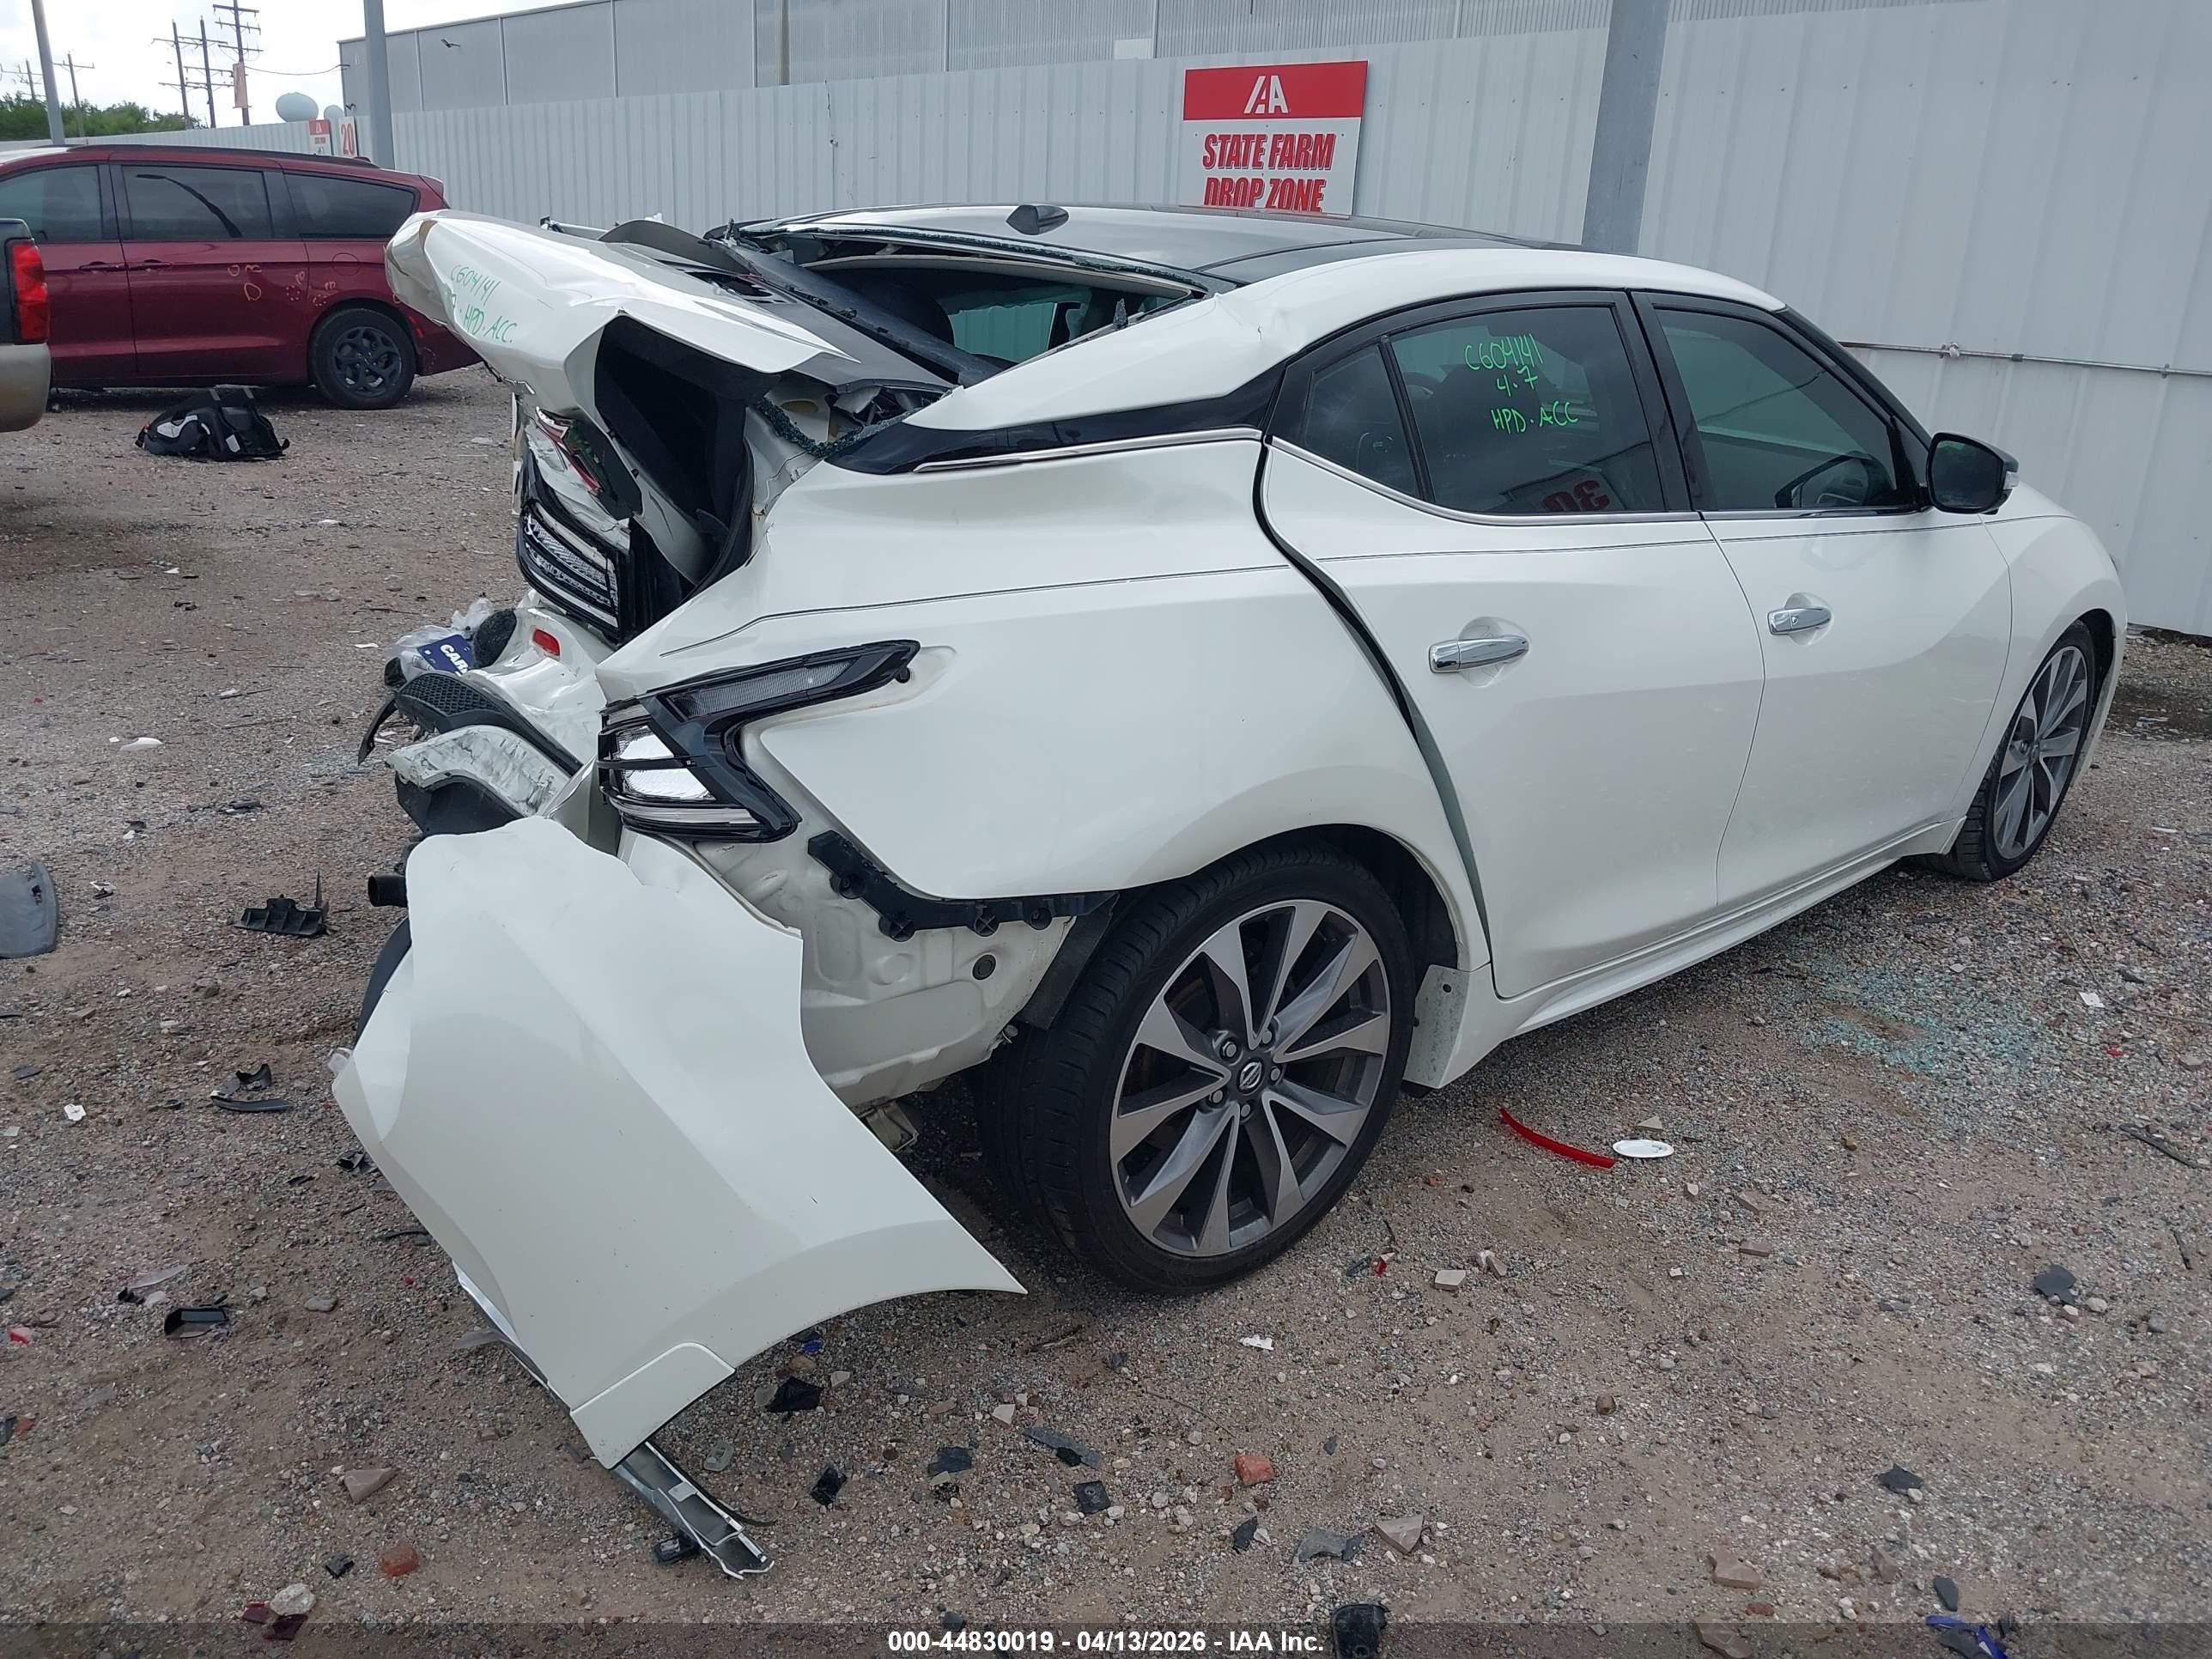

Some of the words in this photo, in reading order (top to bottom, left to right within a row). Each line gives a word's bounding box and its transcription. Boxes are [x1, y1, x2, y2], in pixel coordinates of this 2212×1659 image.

[341, 123, 355, 155] 20
[1202, 133, 1267, 170] STATE
[1267, 133, 1336, 171] FARM
[1203, 177, 1265, 208] DROP
[1264, 178, 1327, 212] ZONE
[1465, 333, 1543, 369] C604141
